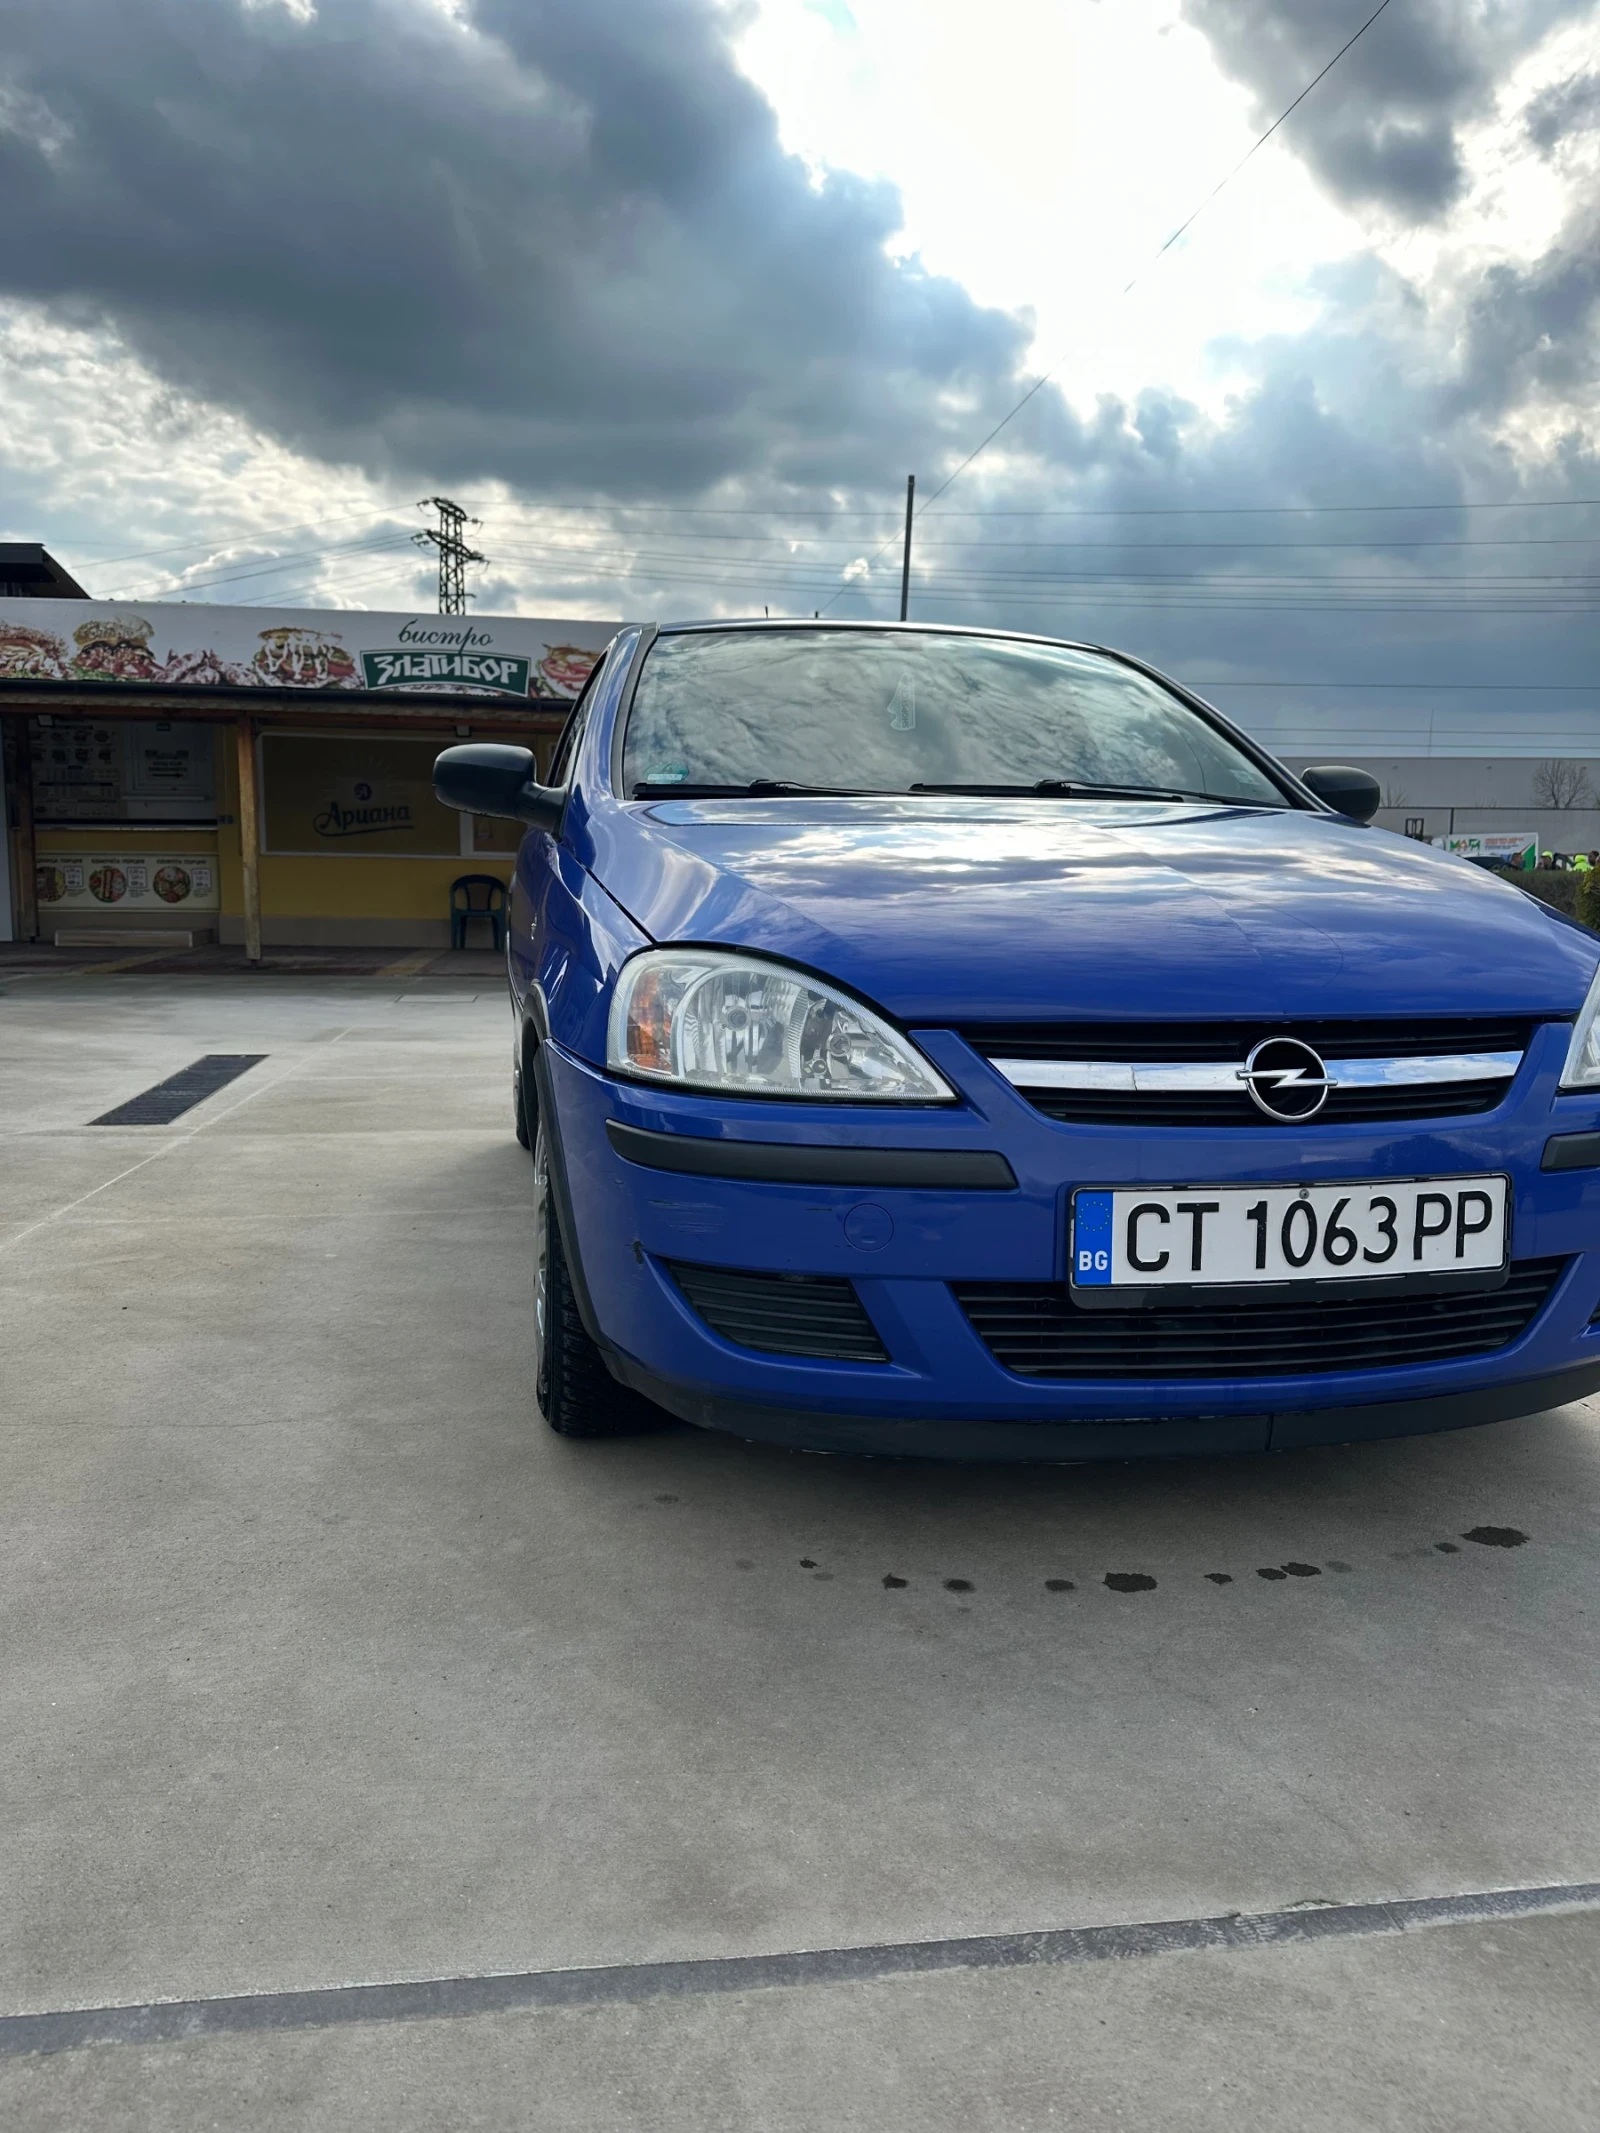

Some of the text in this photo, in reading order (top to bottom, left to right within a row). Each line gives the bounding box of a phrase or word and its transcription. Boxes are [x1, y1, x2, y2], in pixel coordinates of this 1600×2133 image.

[398, 618, 493, 653] бистро
[373, 654, 518, 685] ЗЛАТИБОР
[313, 799, 414, 837] Ариана
[1078, 1250, 1108, 1271] BG
